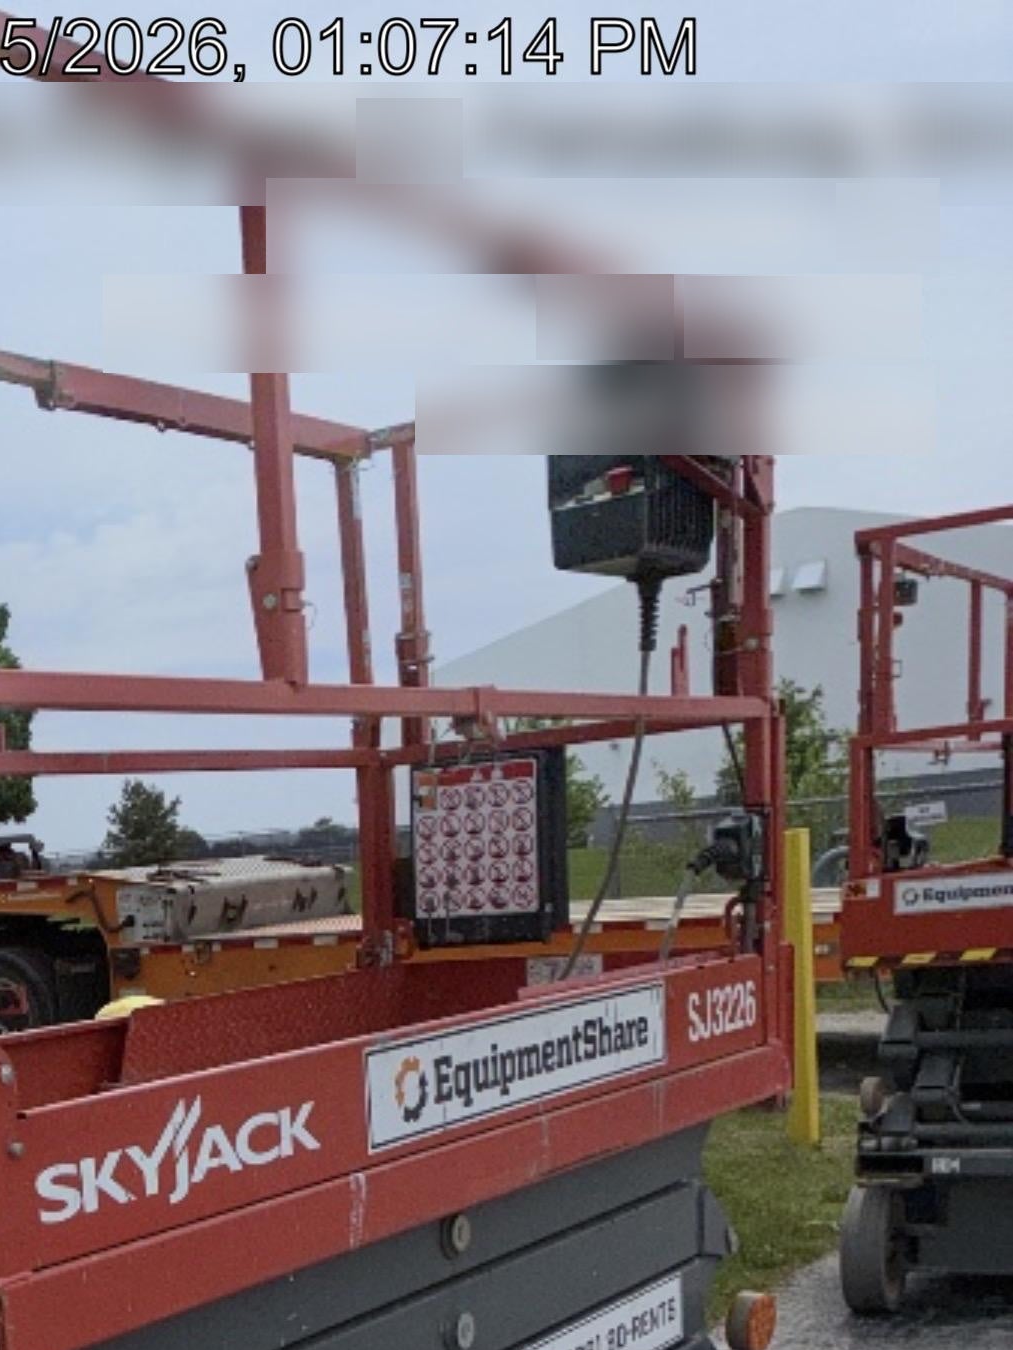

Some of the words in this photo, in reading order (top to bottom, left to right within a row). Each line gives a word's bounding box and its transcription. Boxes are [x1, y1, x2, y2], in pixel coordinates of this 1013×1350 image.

[688, 980, 757, 1042] SJ3226
[434, 1015, 650, 1106] EquipmentShare
[34, 1095, 322, 1225] SKYJACK
